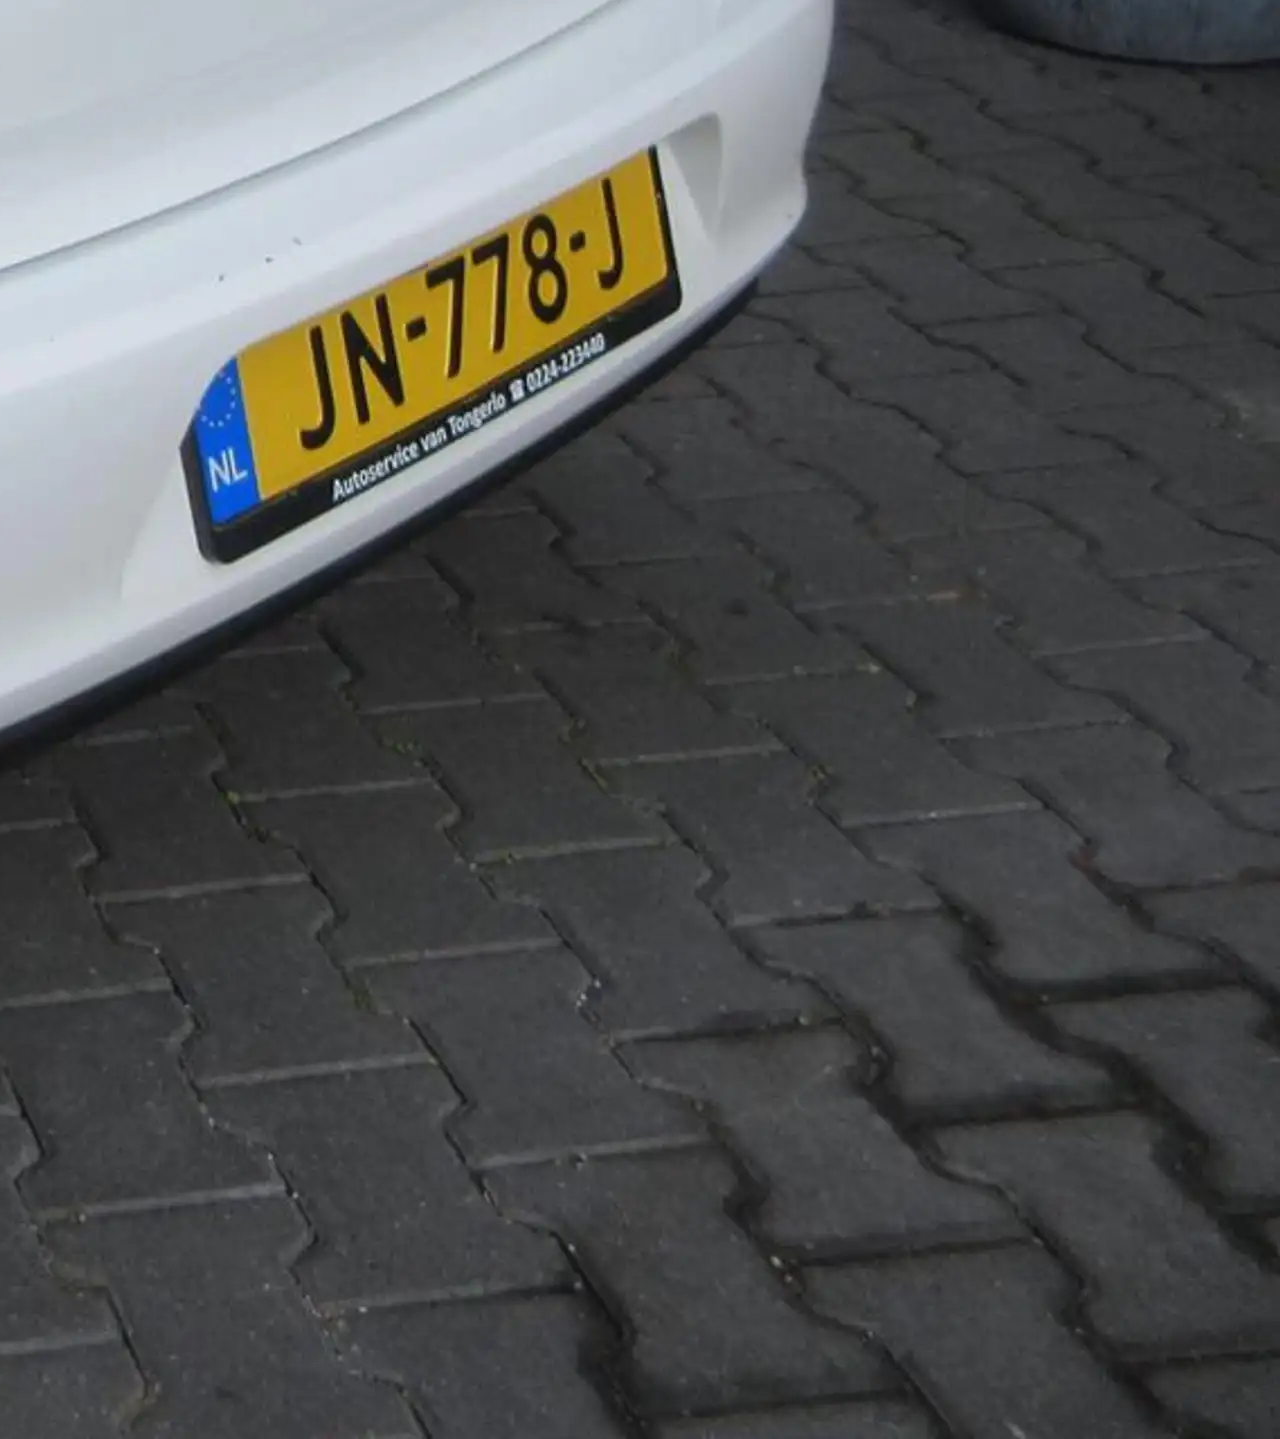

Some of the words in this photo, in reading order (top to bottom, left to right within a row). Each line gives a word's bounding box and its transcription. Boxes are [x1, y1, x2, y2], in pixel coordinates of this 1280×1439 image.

[297, 178, 624, 451] JN-778-J
[207, 447, 248, 493] NL
[332, 440, 420, 501] Autoservice
[420, 427, 447, 452] van
[448, 391, 506, 437] Tongerlo
[526, 332, 606, 393] 0224-223440
